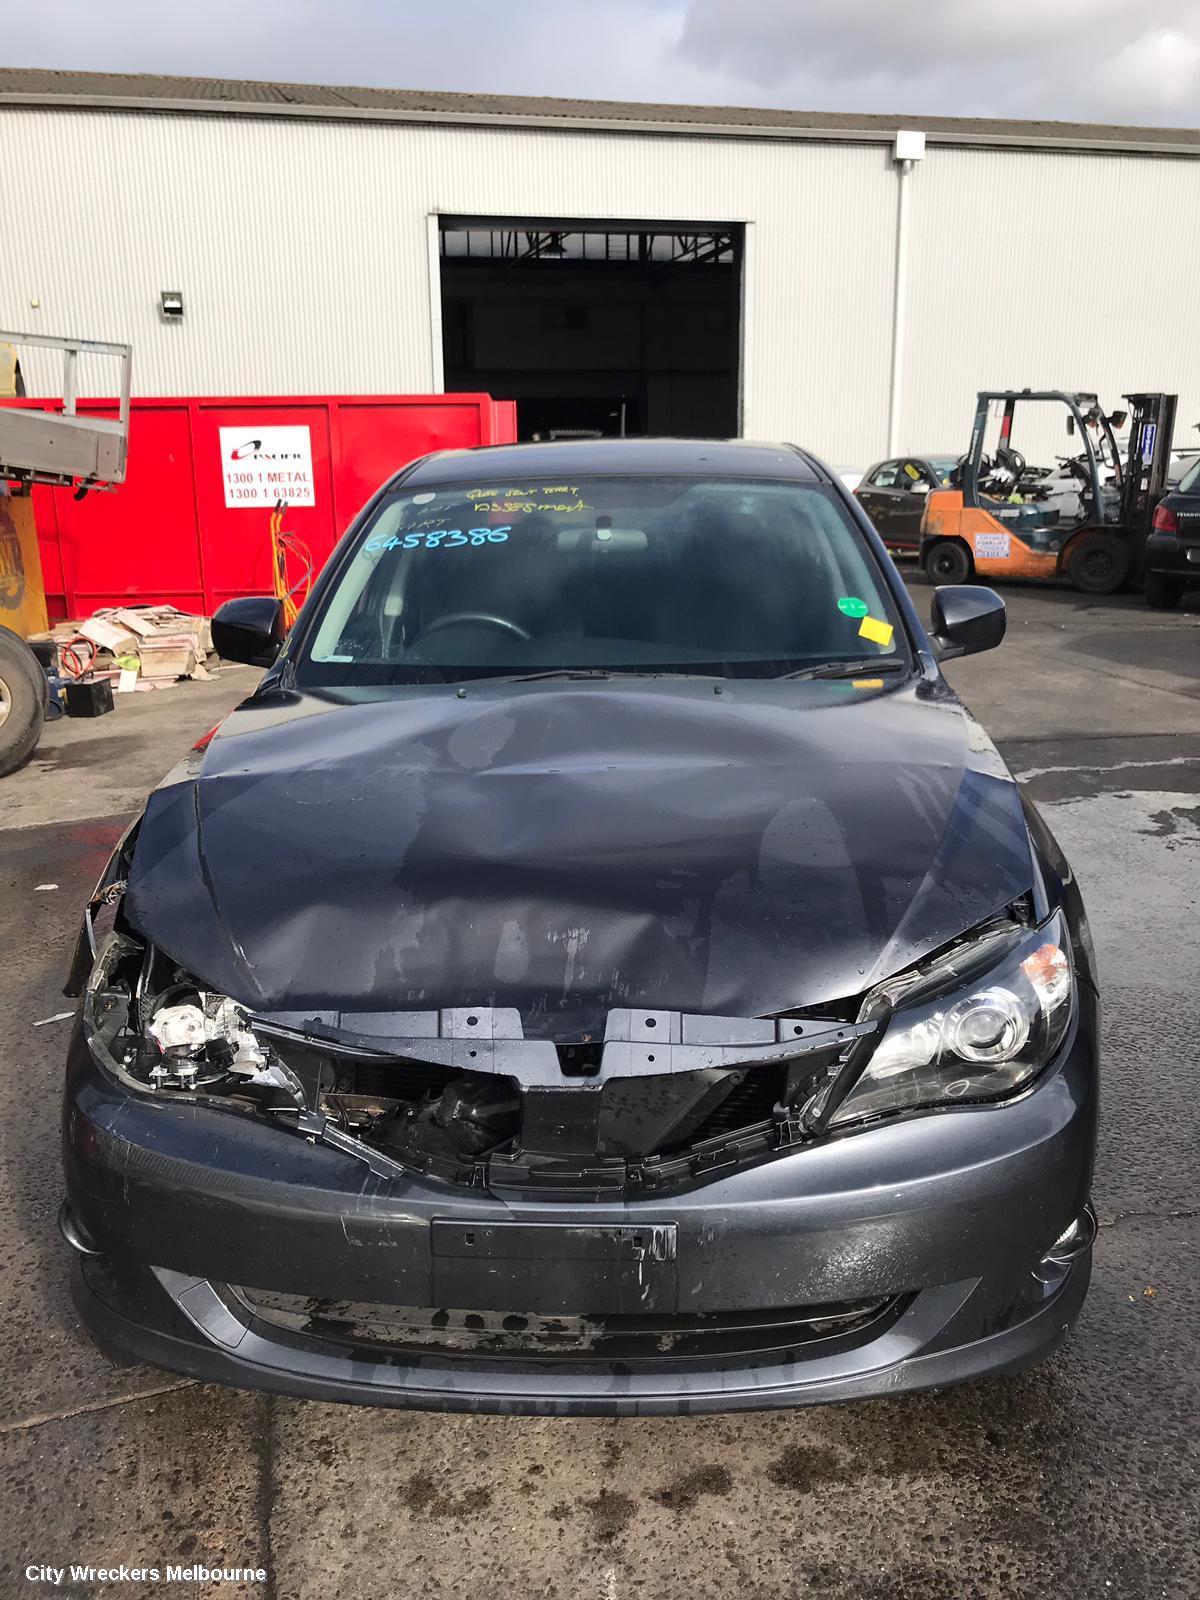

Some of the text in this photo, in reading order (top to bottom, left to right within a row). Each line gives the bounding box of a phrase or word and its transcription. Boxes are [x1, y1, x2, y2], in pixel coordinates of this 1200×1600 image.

[227, 472, 310, 483] 1300 1 METAL
[229, 487, 310, 499] 1300 1 63825
[365, 526, 512, 551] 6458386
